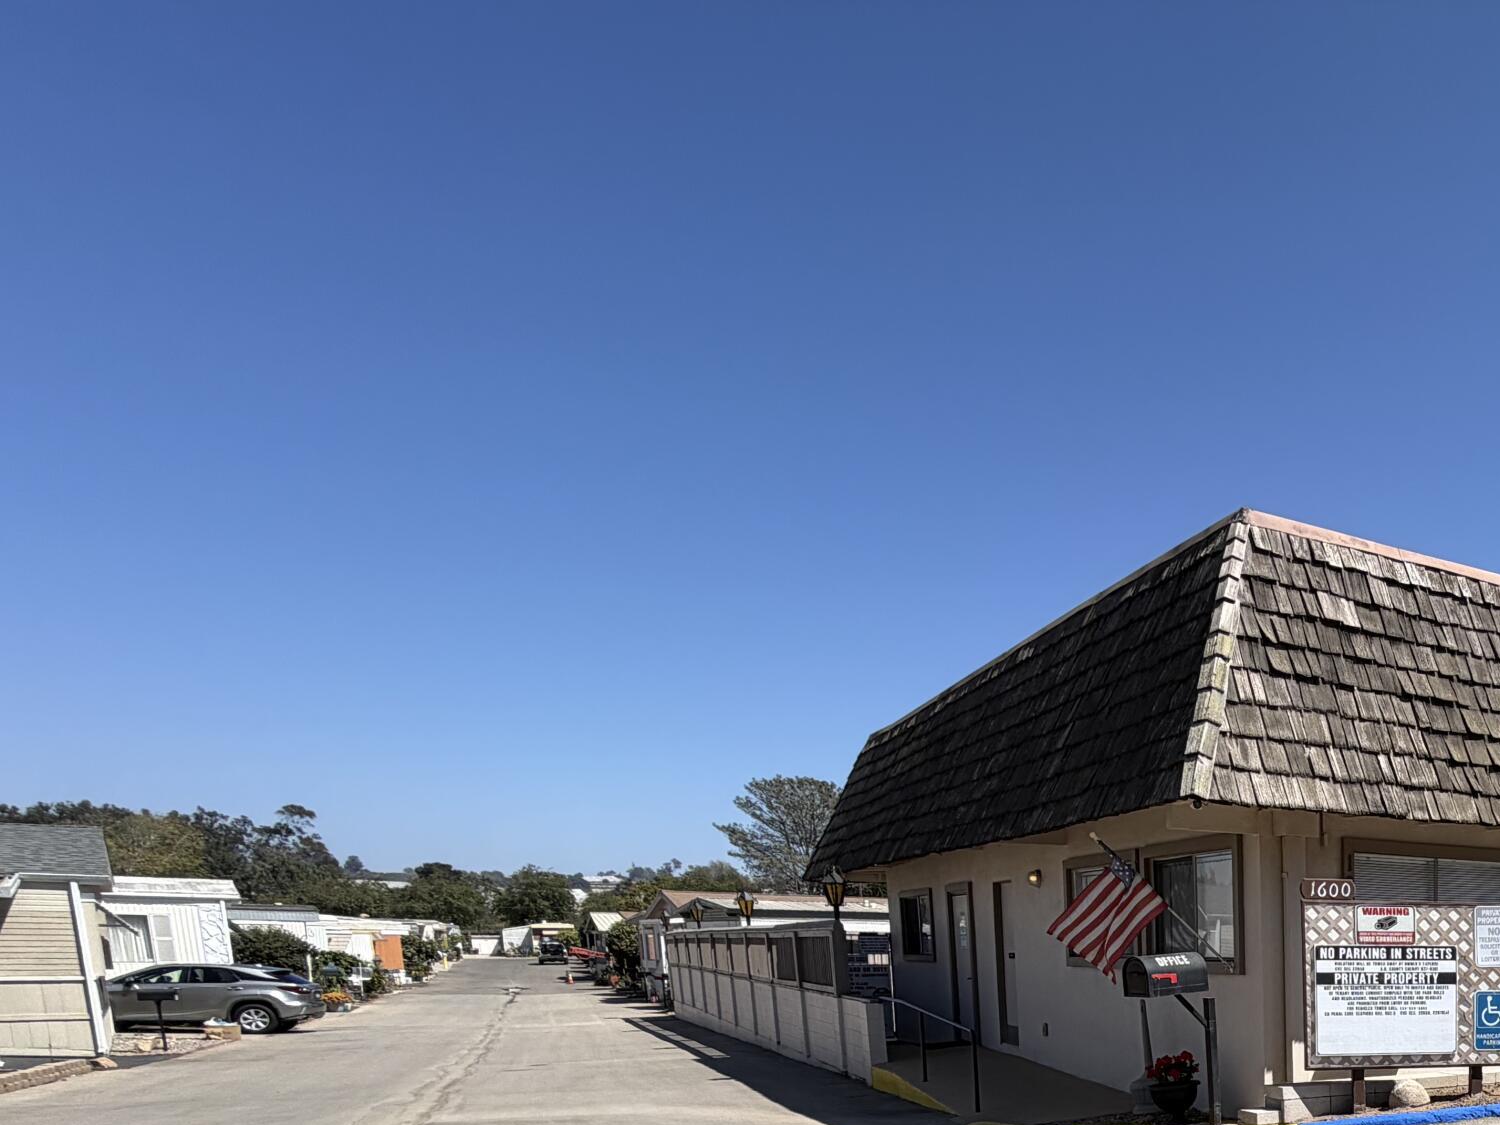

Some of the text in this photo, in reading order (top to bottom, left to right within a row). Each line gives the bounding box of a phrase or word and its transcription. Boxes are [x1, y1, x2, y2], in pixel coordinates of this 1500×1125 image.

[1311, 882, 1350, 897] 1600
[1362, 908, 1410, 916] WARNING
[1488, 927, 1500, 936] NO
[1320, 948, 1453, 960] NO PARKING IN STREETS
[1155, 955, 1191, 967] OFFICE
[1335, 973, 1439, 984] PRIVATE PROPERTY
